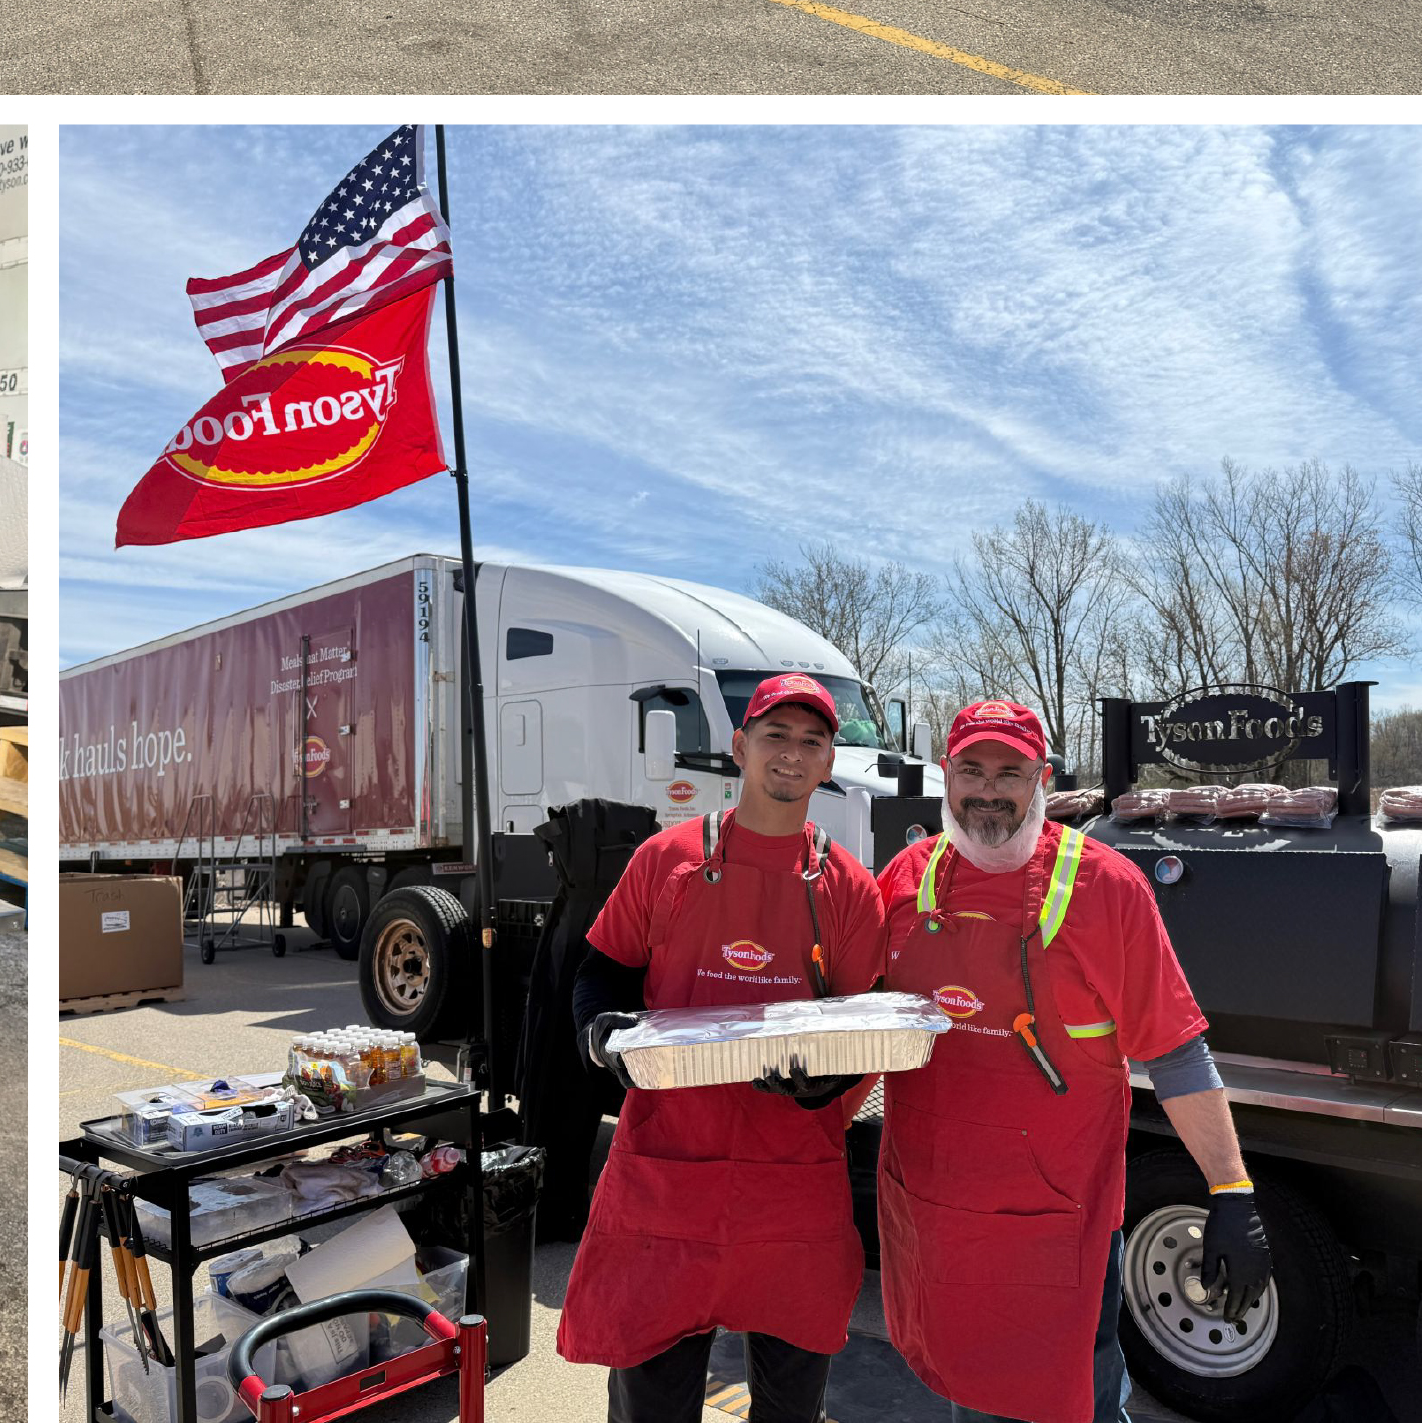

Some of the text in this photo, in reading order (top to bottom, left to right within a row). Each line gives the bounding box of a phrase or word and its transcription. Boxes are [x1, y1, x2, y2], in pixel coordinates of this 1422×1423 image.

[419, 581, 430, 643] 59194
[281, 654, 302, 671] Meals
[1141, 707, 1324, 753] Tyson Foods
[74, 726, 127, 779] hauls
[131, 720, 193, 777] hope.
[443, 863, 476, 872] KENWOR
[87, 887, 124, 901] Trash
[723, 944, 751, 959] Tyson
[724, 971, 737, 980] the
[956, 994, 984, 1009] Foods
[951, 1020, 967, 1031] orld
[967, 1021, 982, 1033] like
